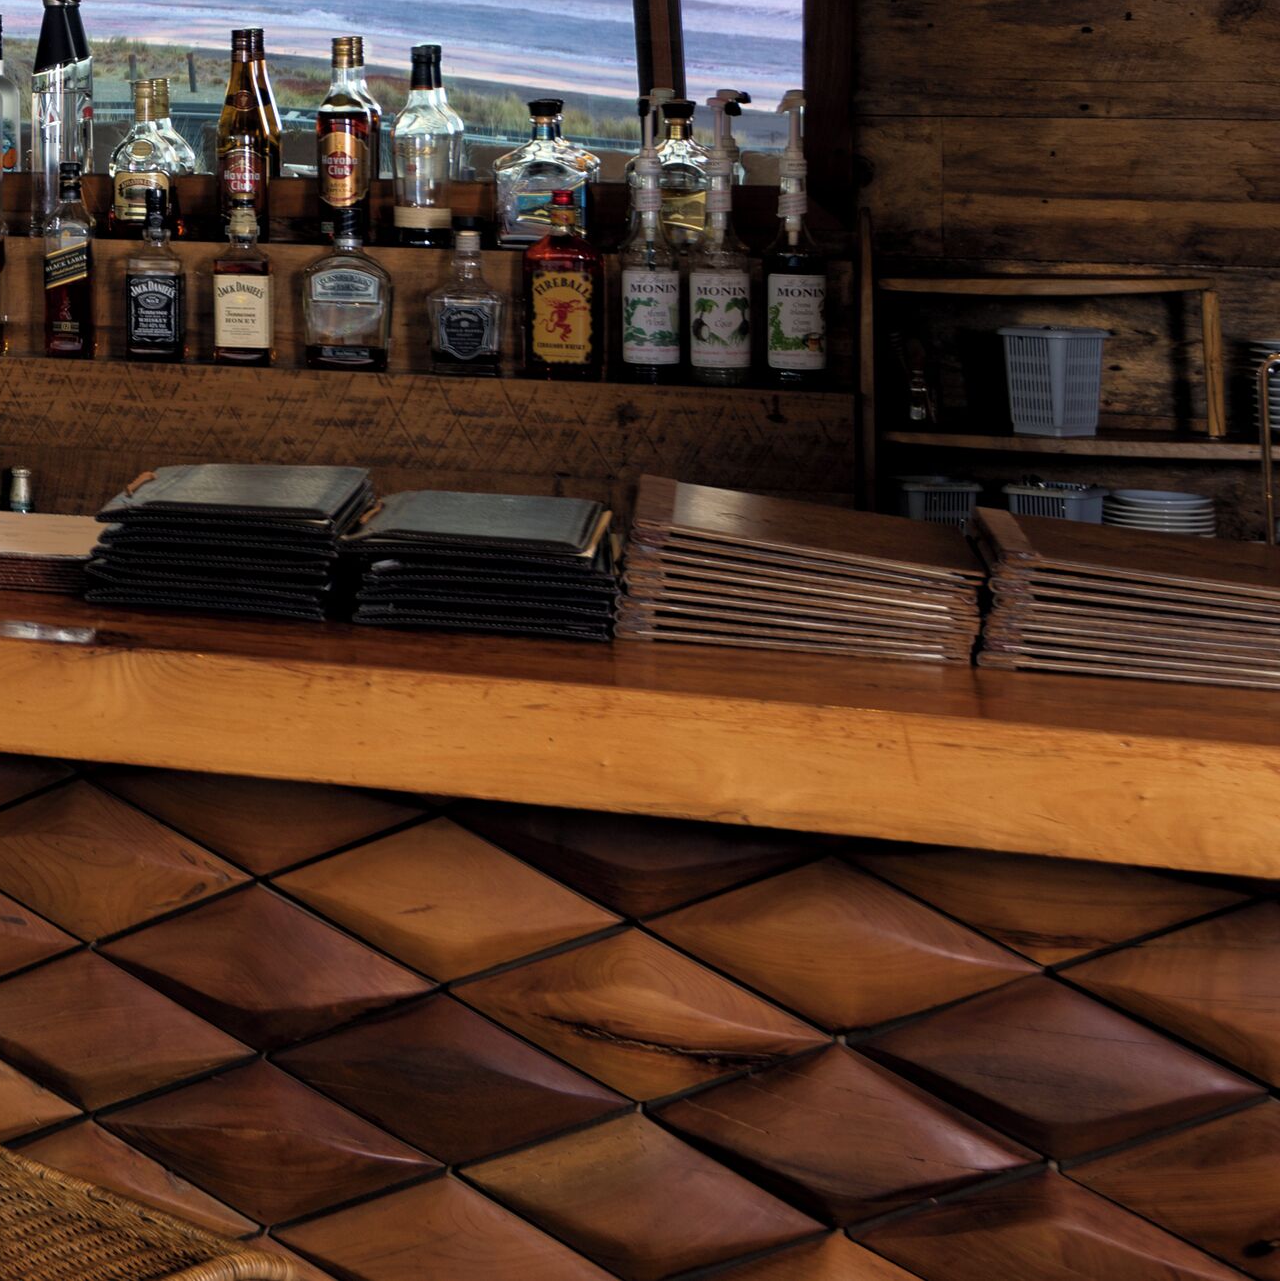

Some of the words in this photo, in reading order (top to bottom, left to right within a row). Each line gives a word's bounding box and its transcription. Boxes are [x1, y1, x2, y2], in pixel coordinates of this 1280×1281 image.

[322, 154, 357, 165] Havana
[224, 170, 260, 180] Havana
[328, 165, 351, 176] Club
[231, 180, 253, 191] Club
[45, 262, 67, 272] BLACK
[66, 254, 88, 266] LABEL
[131, 284, 149, 297] JACK
[147, 280, 177, 299] DANIEL'S
[217, 285, 236, 298] JACK
[235, 280, 264, 300] DANIEL'S
[534, 277, 590, 298] FIREBALL
[630, 283, 677, 294] MONIN
[696, 286, 746, 296] MONIN
[224, 317, 257, 325] HONEY
